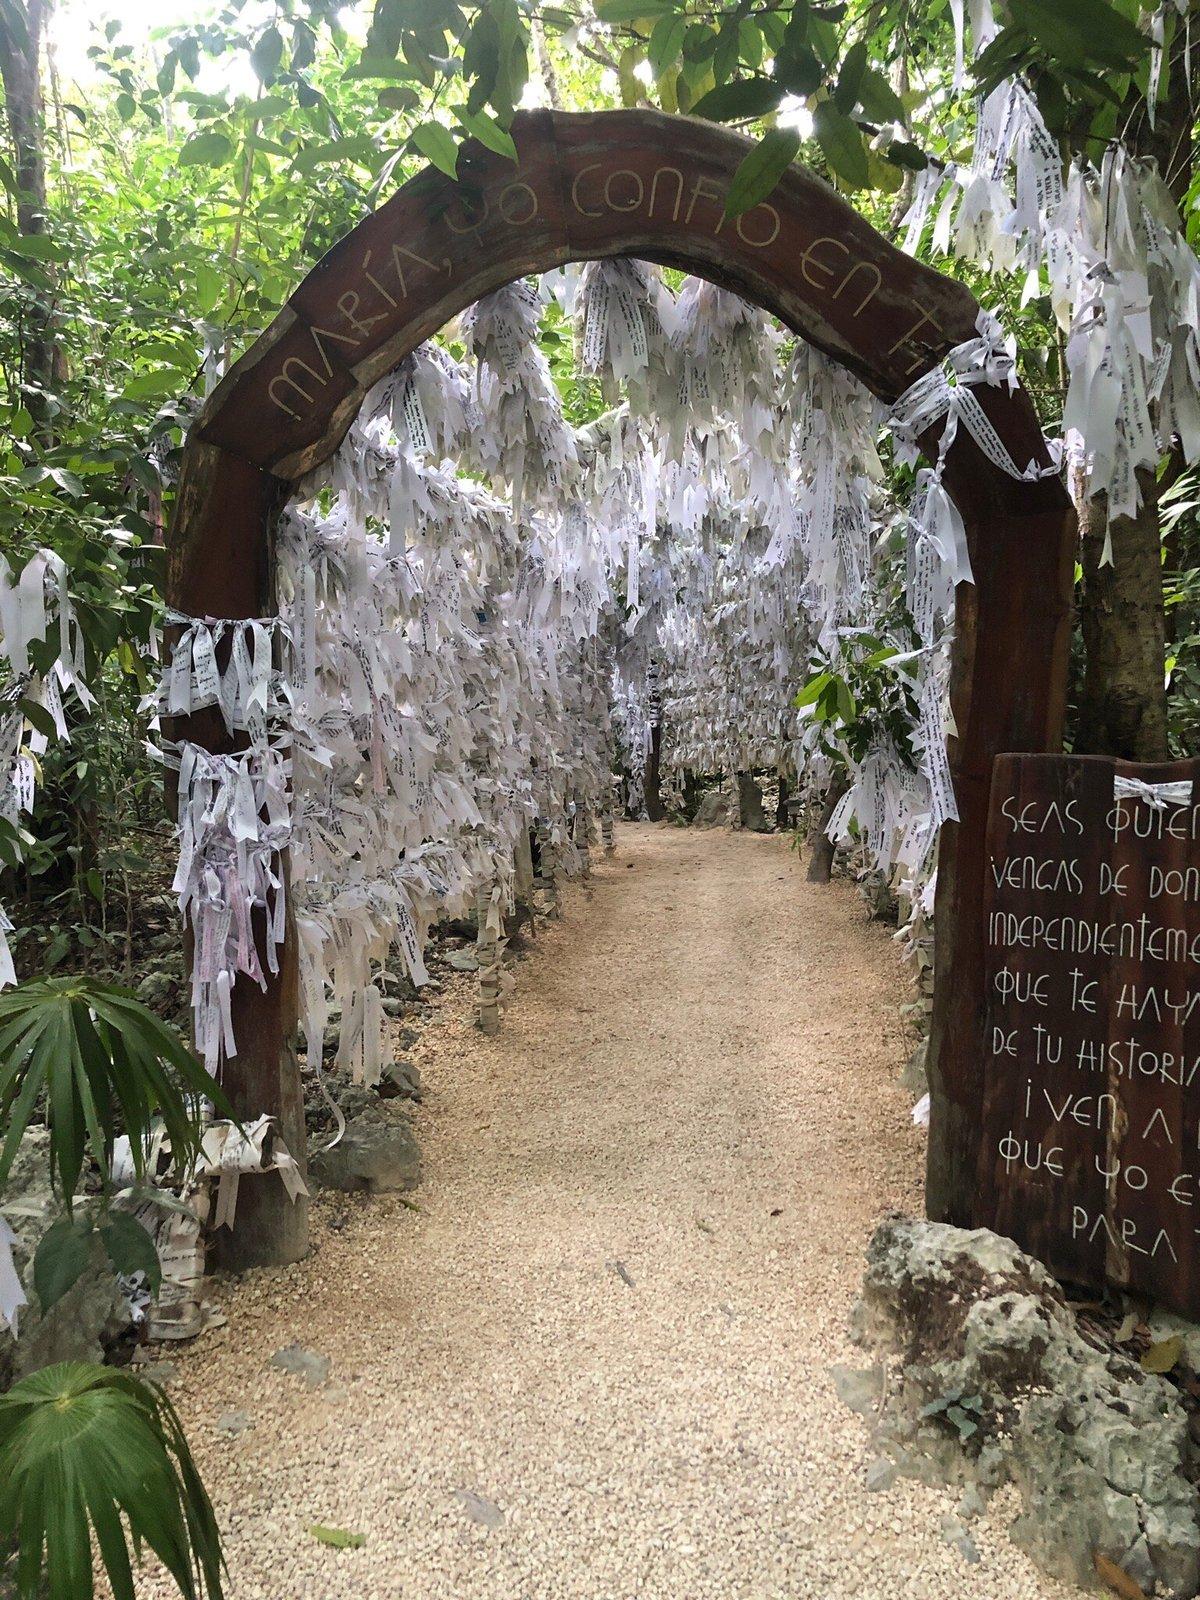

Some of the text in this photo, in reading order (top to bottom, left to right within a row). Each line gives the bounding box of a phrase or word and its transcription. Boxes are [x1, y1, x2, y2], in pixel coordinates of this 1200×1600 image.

[800, 237, 882, 318] EN
[1001, 796, 1084, 835] SEAS
[990, 856, 1199, 902] VENGAS DE DON
[989, 912, 1200, 963] INDEPENDIENTEME
[994, 966, 1050, 1006] QUE
[1069, 967, 1098, 1013] TE
[993, 1026, 1018, 1056] DE
[1032, 1023, 1062, 1065] TU
[1142, 1108, 1173, 1144] A
[998, 1130, 1064, 1176] QUE
[1095, 1154, 1148, 1190] YO
[1072, 1205, 1178, 1264] PARA
